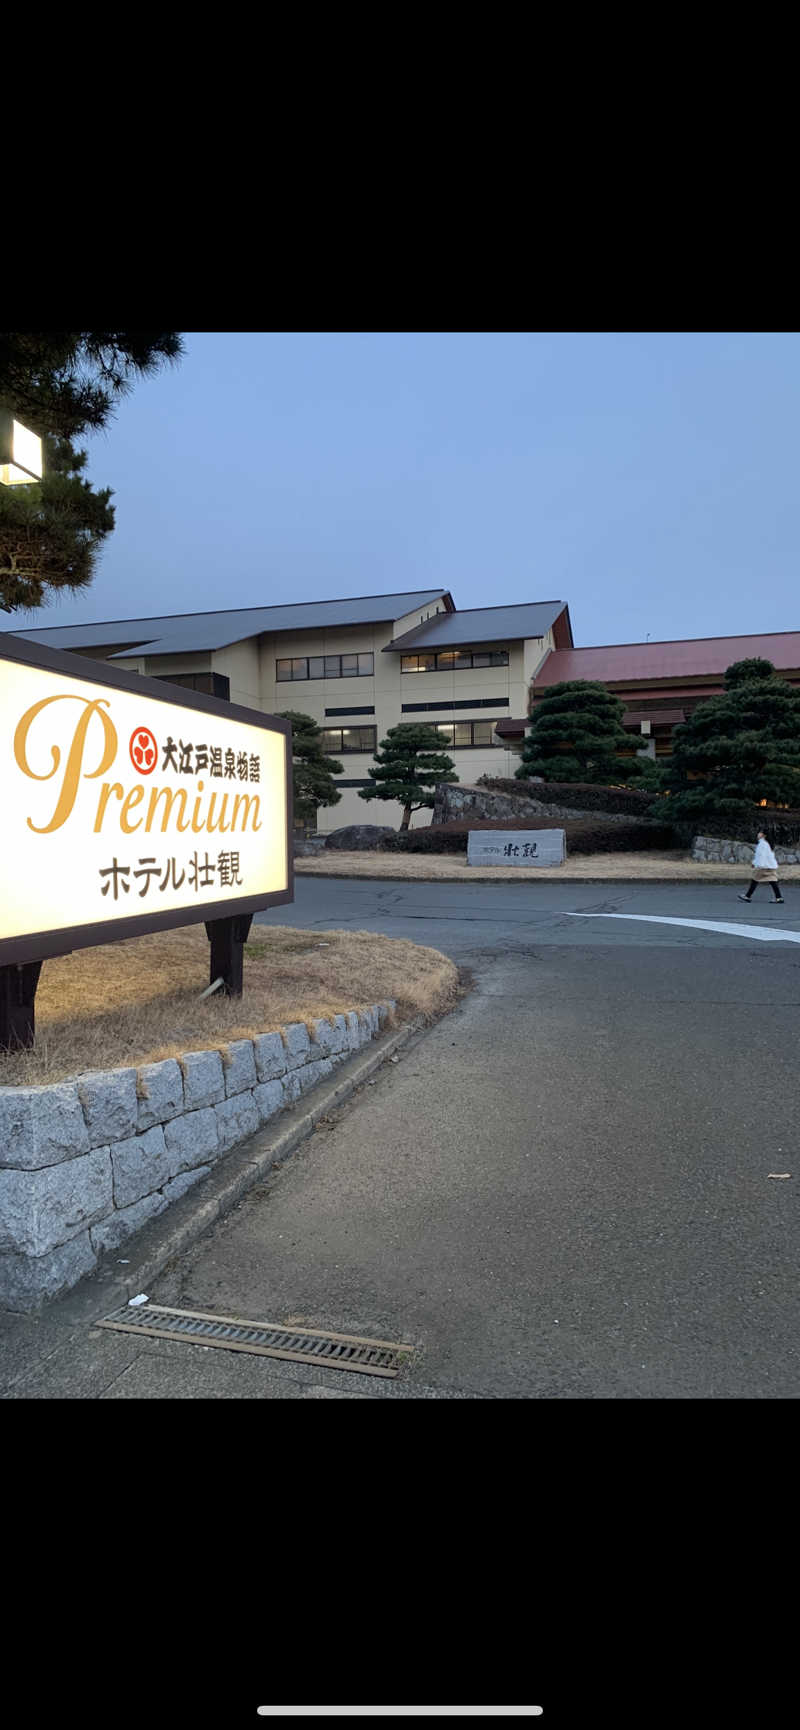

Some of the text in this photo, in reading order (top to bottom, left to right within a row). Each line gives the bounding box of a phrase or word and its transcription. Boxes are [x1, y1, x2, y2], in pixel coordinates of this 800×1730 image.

[14, 694, 263, 835] Premium
[162, 736, 261, 783] 大江戸温泉物語
[99, 850, 243, 900] ホテル壮観
